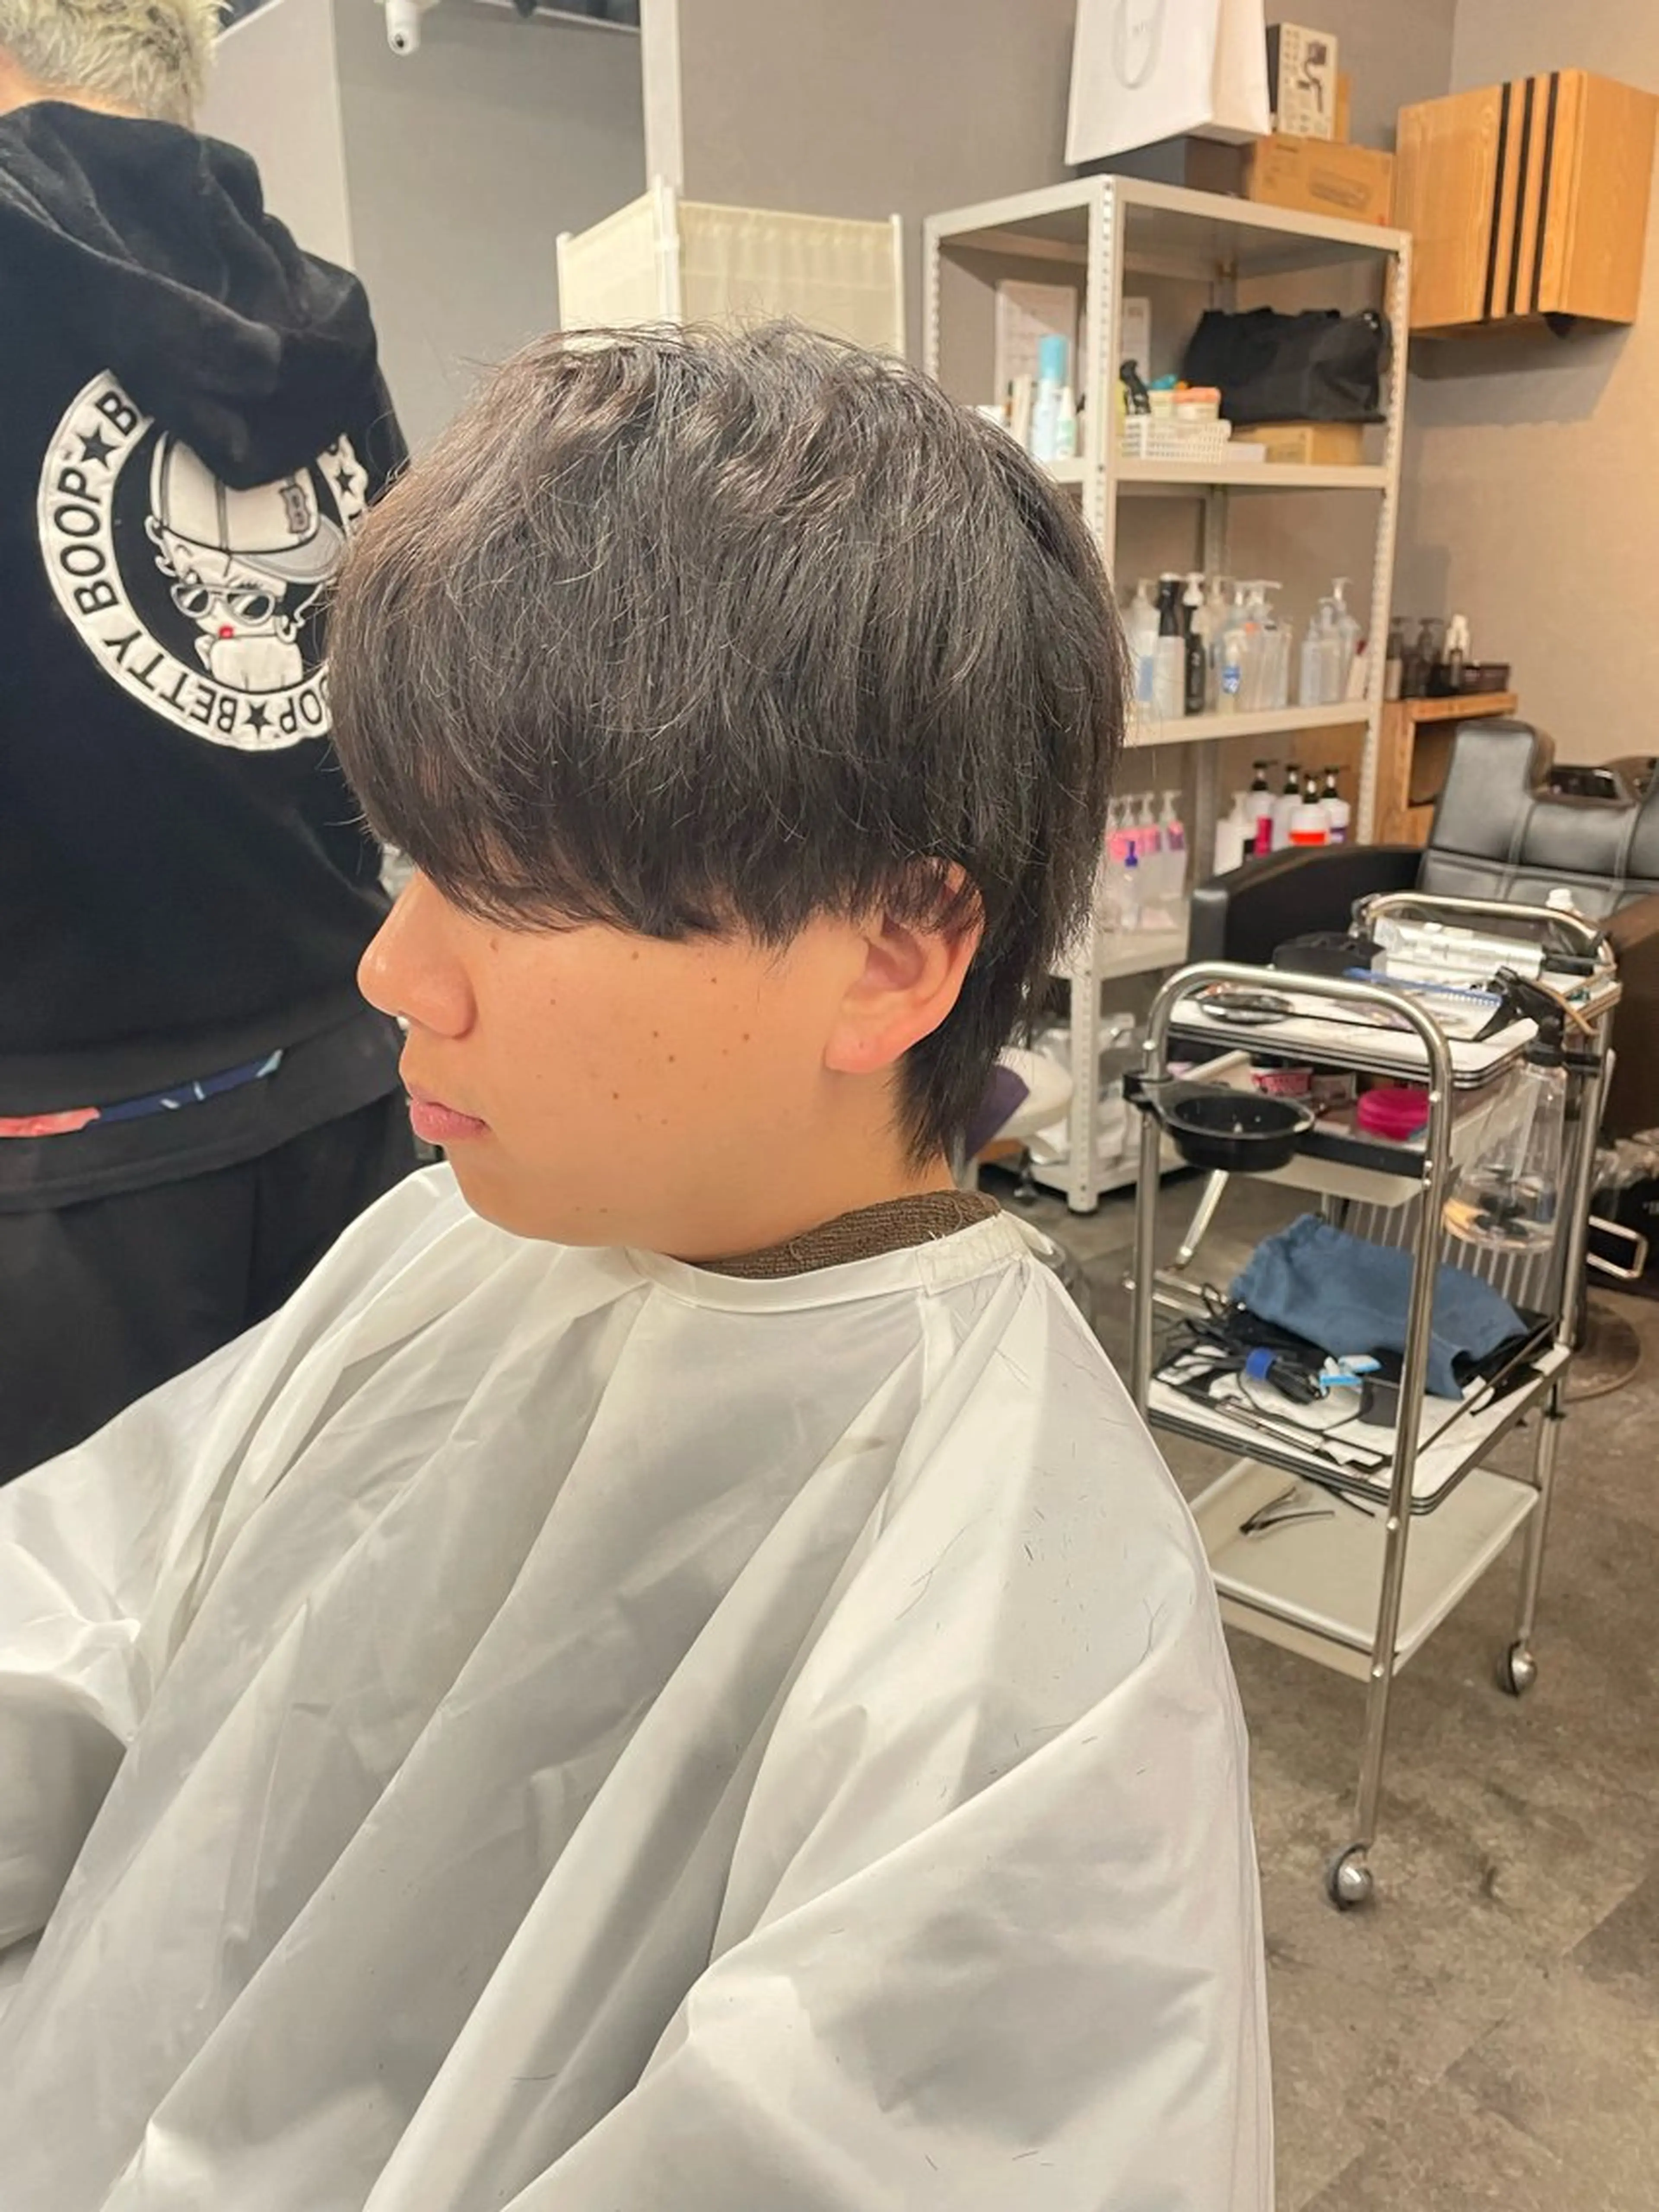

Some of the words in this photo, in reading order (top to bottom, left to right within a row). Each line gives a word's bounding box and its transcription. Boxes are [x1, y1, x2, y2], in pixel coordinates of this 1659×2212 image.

[54, 467, 121, 615] BOOP
[102, 630, 237, 734] BETTY
[280, 675, 329, 734] OP
